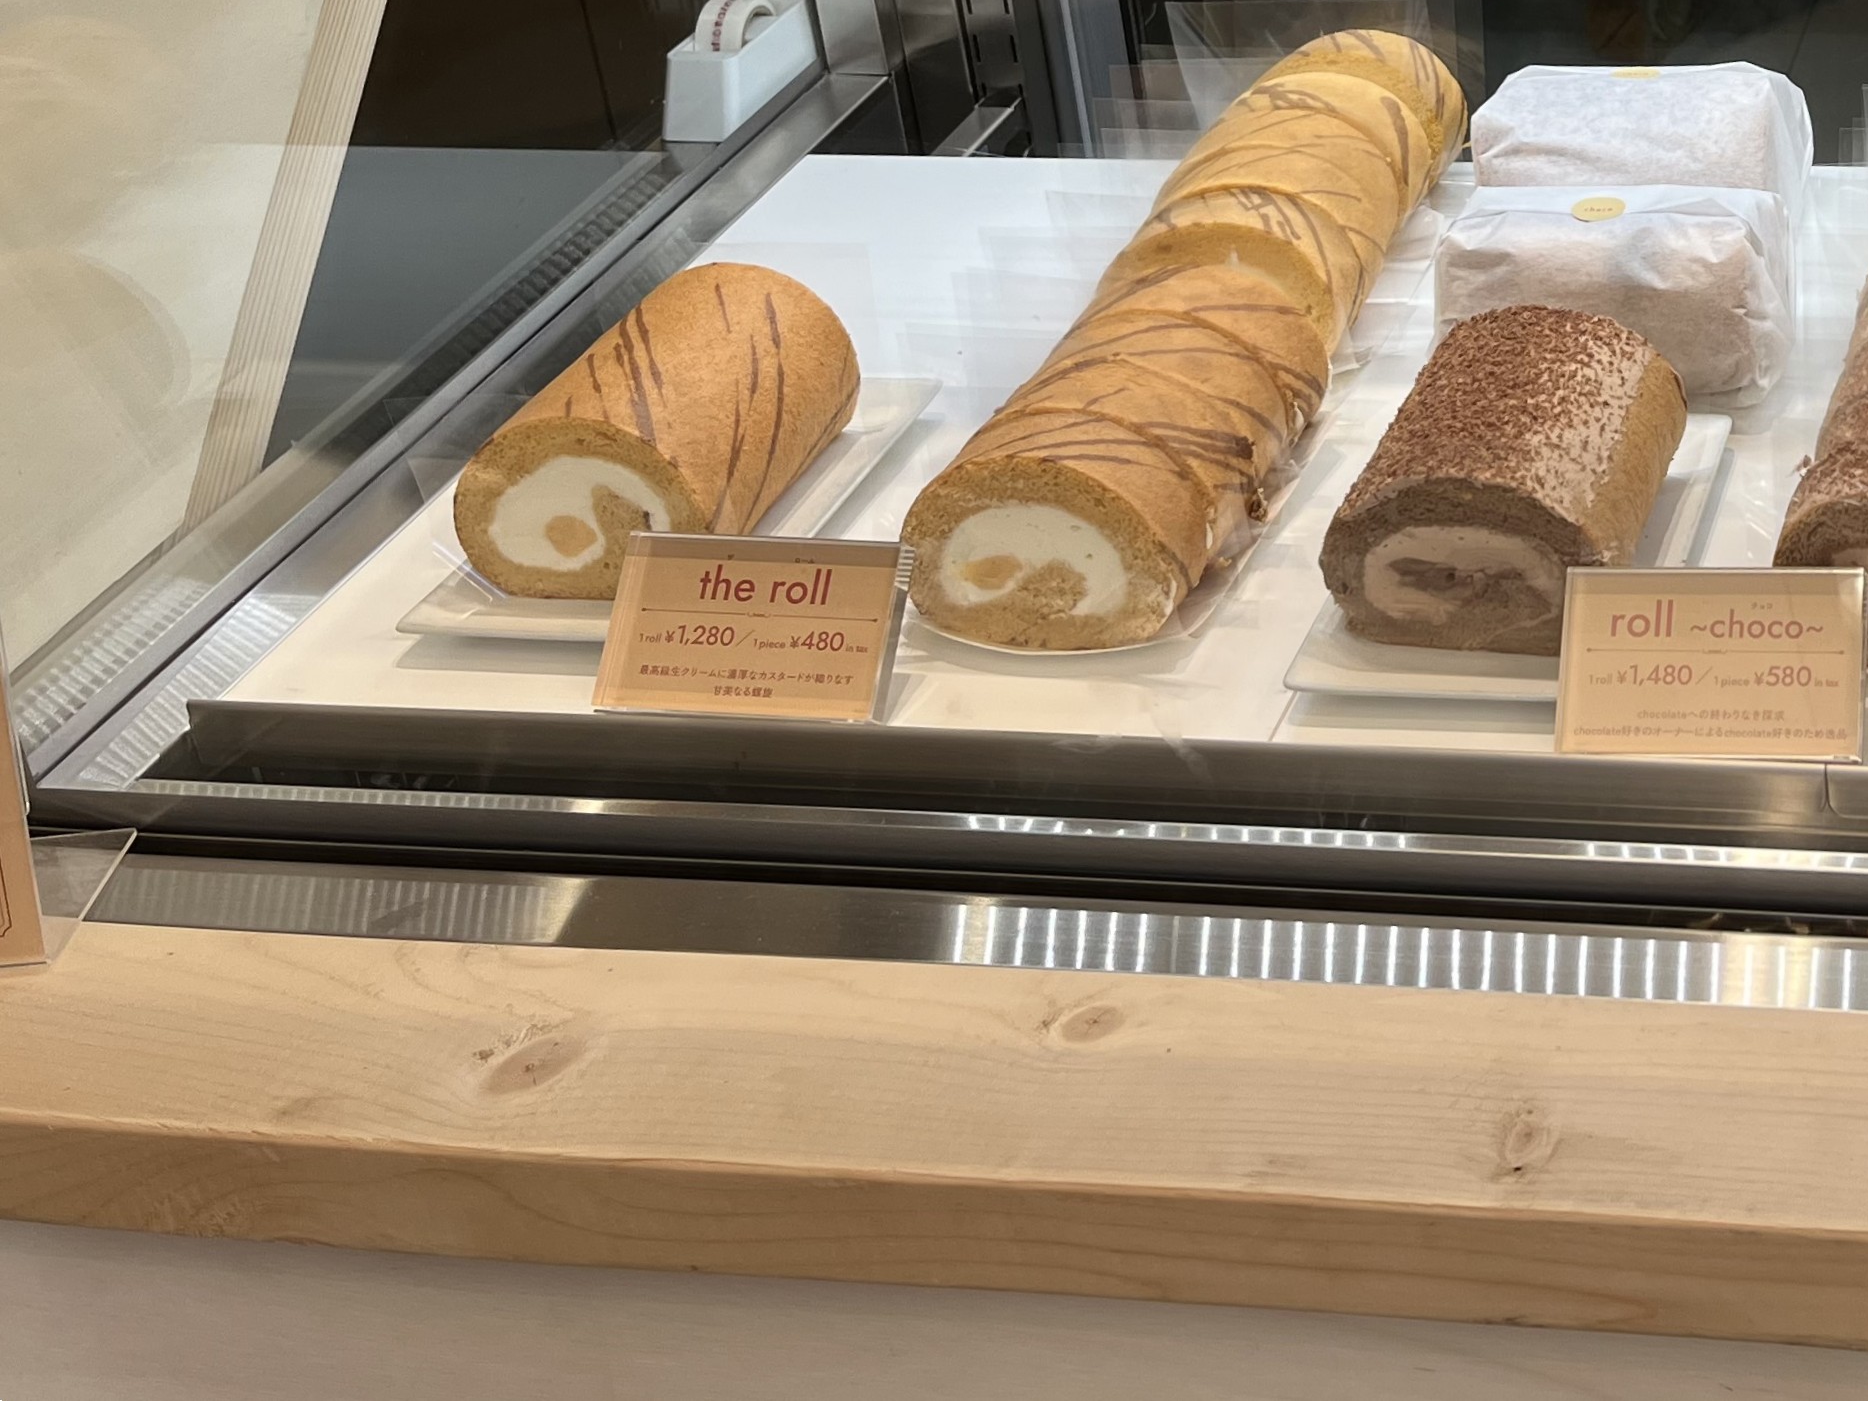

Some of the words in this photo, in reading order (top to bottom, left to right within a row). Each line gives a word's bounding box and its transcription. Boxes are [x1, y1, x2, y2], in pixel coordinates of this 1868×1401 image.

[700, 564, 755, 602] the
[769, 568, 833, 605] roll
[1610, 599, 1674, 638] roll
[665, 625, 735, 647] ¥1,280
[790, 631, 845, 652] ¥480
[1617, 664, 1692, 687] ¥1,480
[1754, 665, 1812, 687] ¥580
